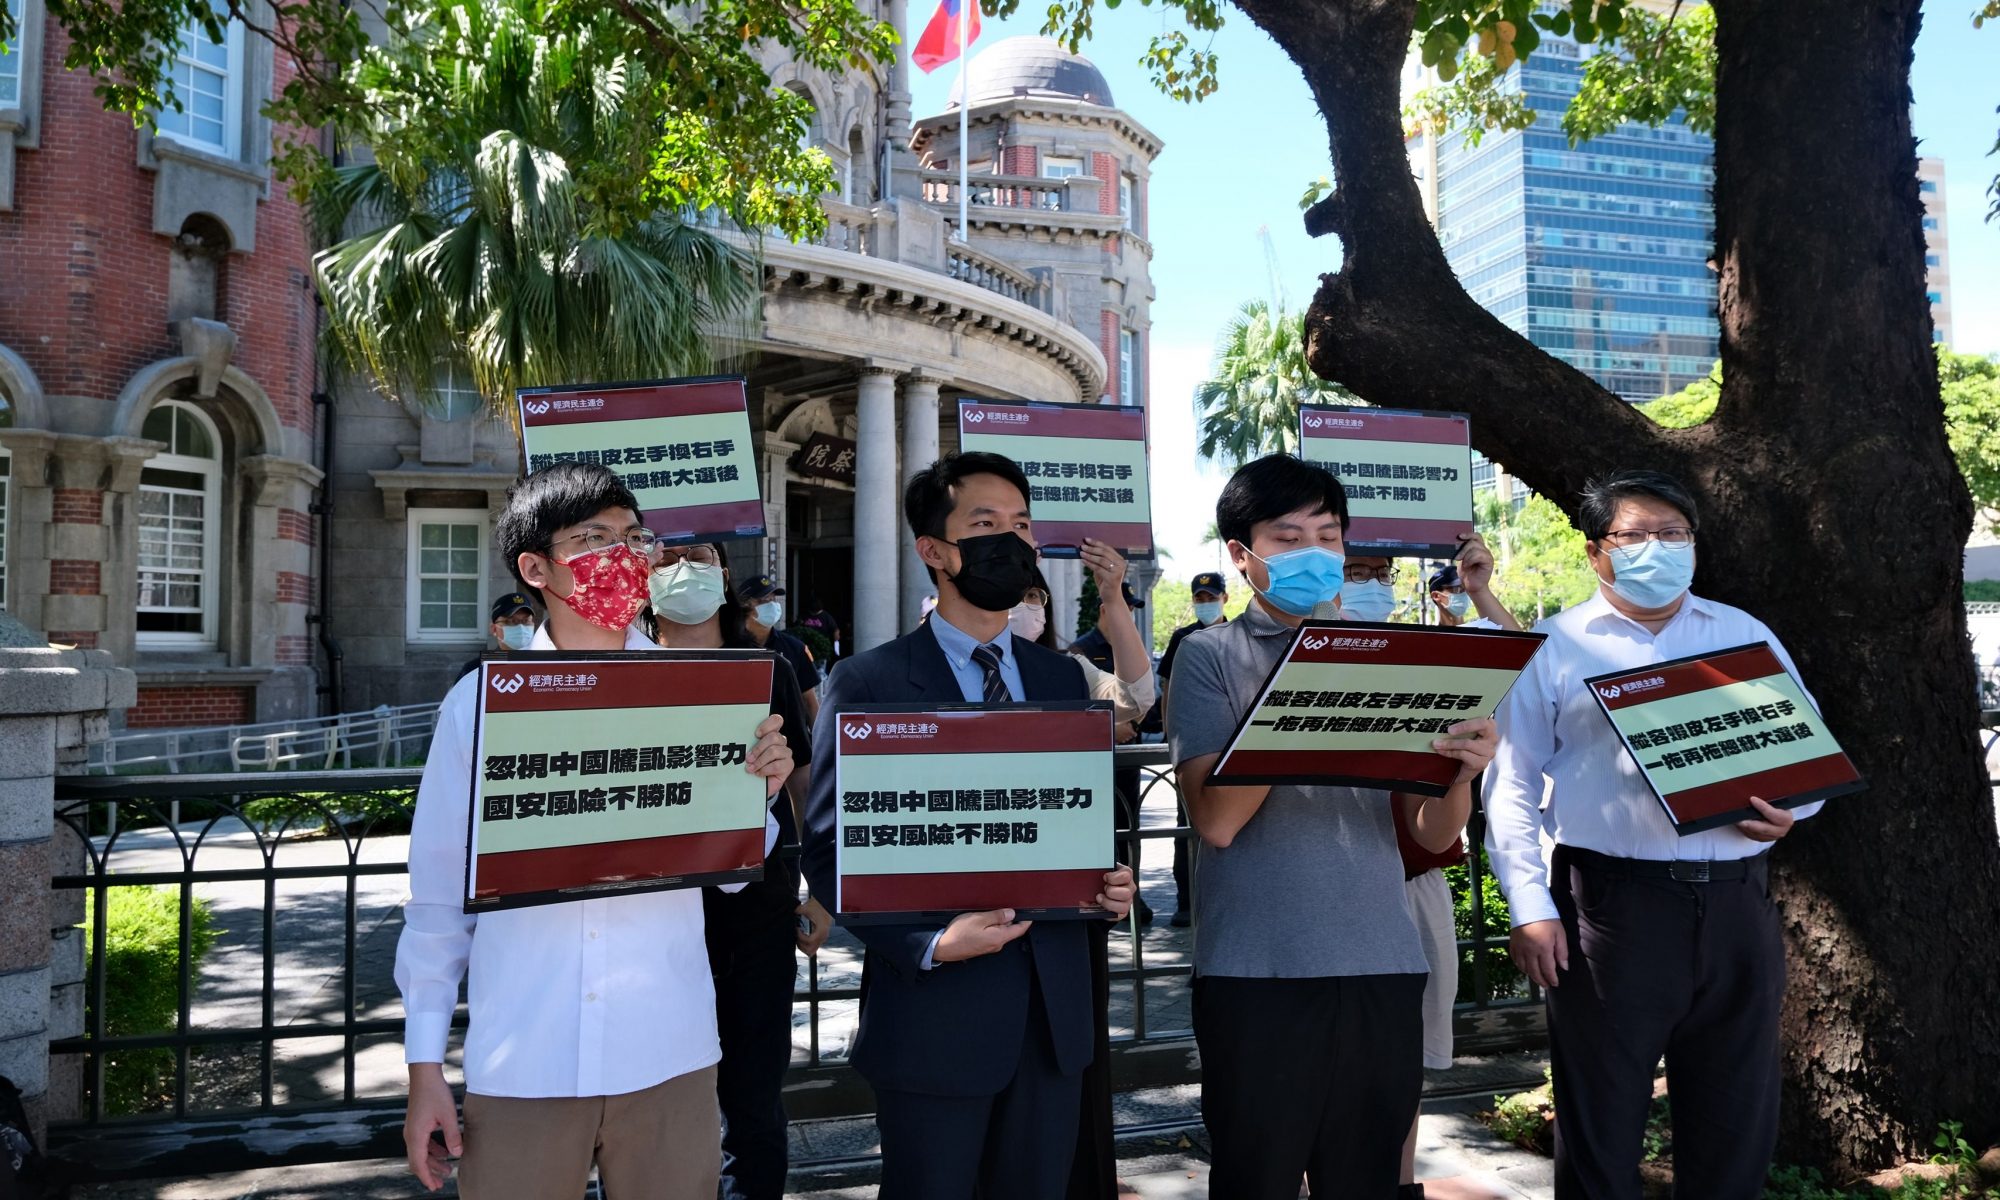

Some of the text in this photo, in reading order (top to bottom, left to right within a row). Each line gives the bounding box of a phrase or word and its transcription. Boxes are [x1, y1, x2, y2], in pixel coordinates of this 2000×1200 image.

[1015, 461, 1133, 480] 皮左手換右手
[1331, 637, 1389, 648] 經濟民主連合
[529, 674, 598, 687] 經濟民主連合
[1261, 689, 1483, 710] 縱容蝦皮左手換右手
[876, 723, 938, 734] 經濟民主連合
[1627, 699, 1796, 751] 縱容蝦皮左手換右手
[1644, 721, 1815, 770] 一拖再拖總統大選後
[484, 743, 747, 782] 忽視中國騰訊影響力
[482, 781, 693, 822] 國安風險不勝防
[842, 788, 1093, 813] 忽視中國騰訊影響力
[843, 821, 1038, 847] 國安風險不勝防
